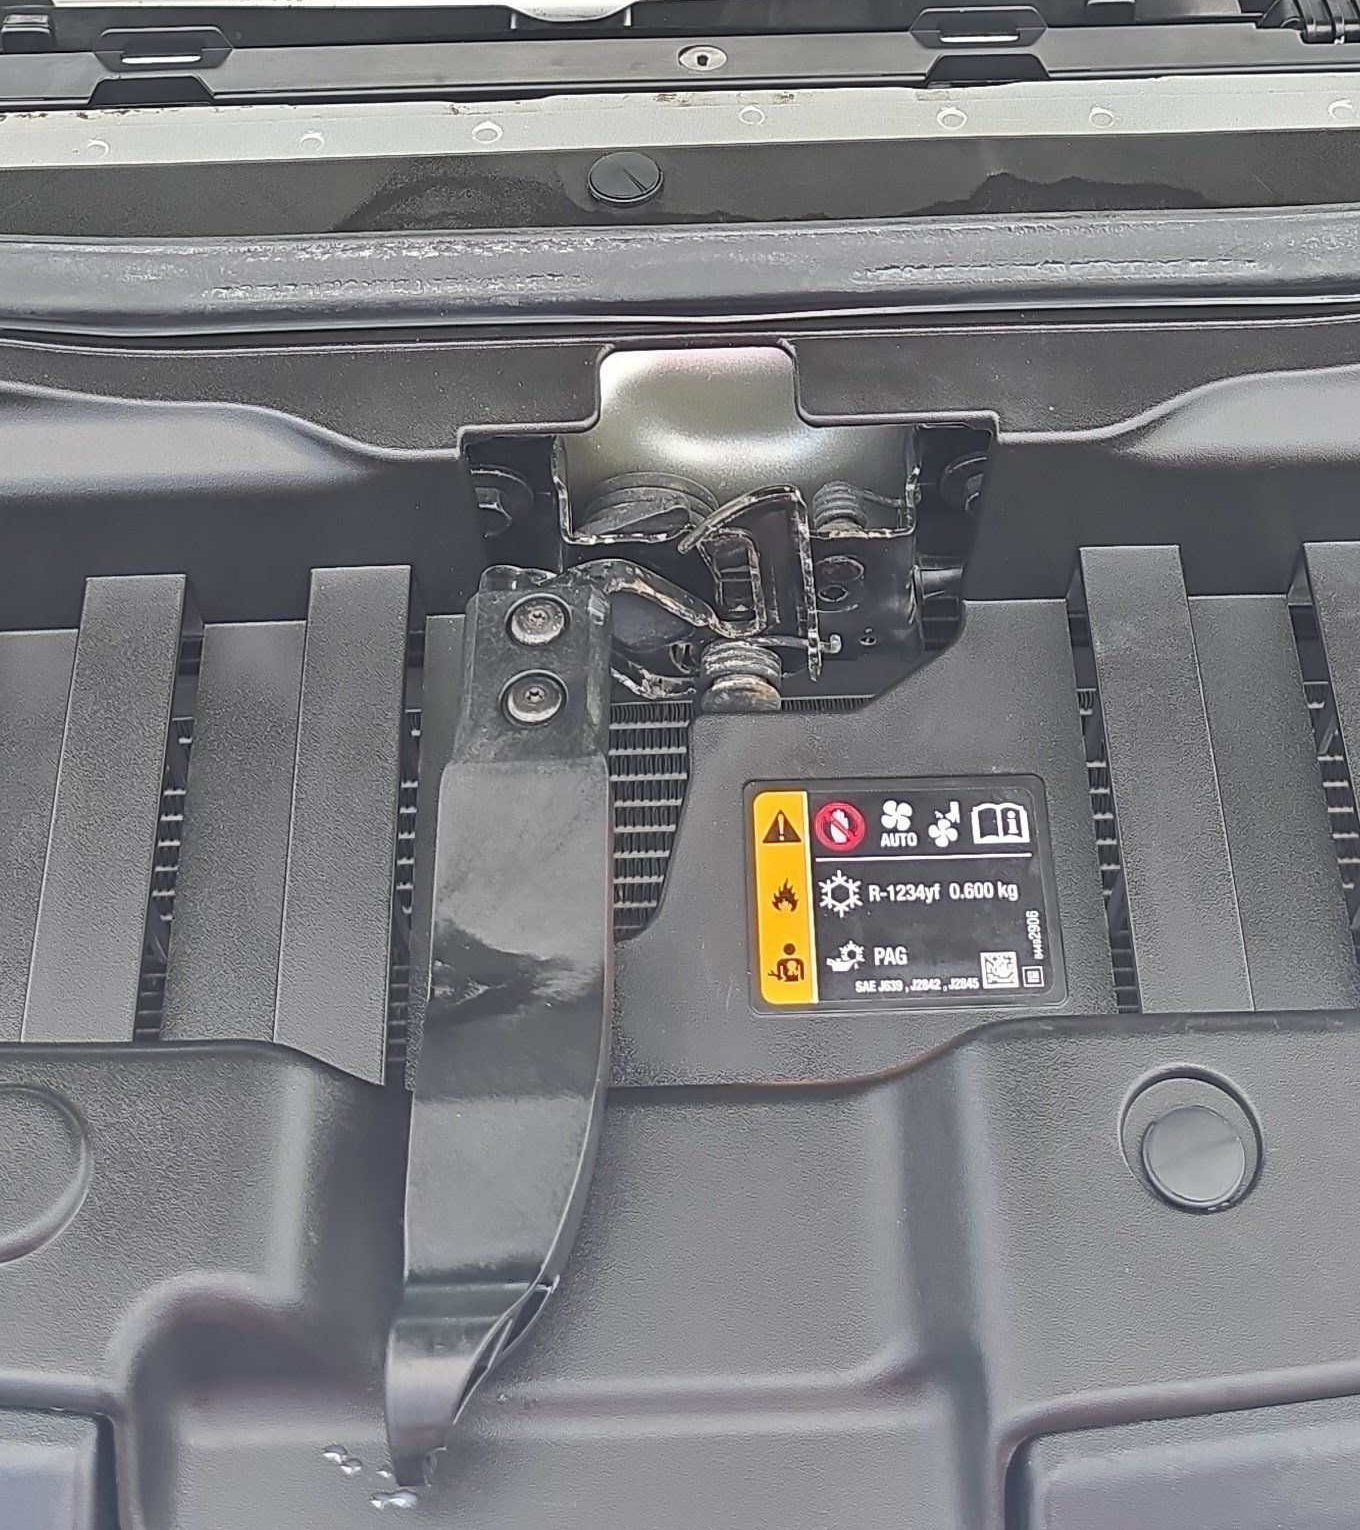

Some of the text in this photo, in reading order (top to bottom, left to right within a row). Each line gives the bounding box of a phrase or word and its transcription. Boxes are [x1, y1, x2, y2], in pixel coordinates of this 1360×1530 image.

[880, 832, 918, 848] AUTO
[868, 880, 1020, 904] R-1234yf 0.600 kg
[873, 945, 909, 966] PAG
[854, 980, 877, 993] SAE
